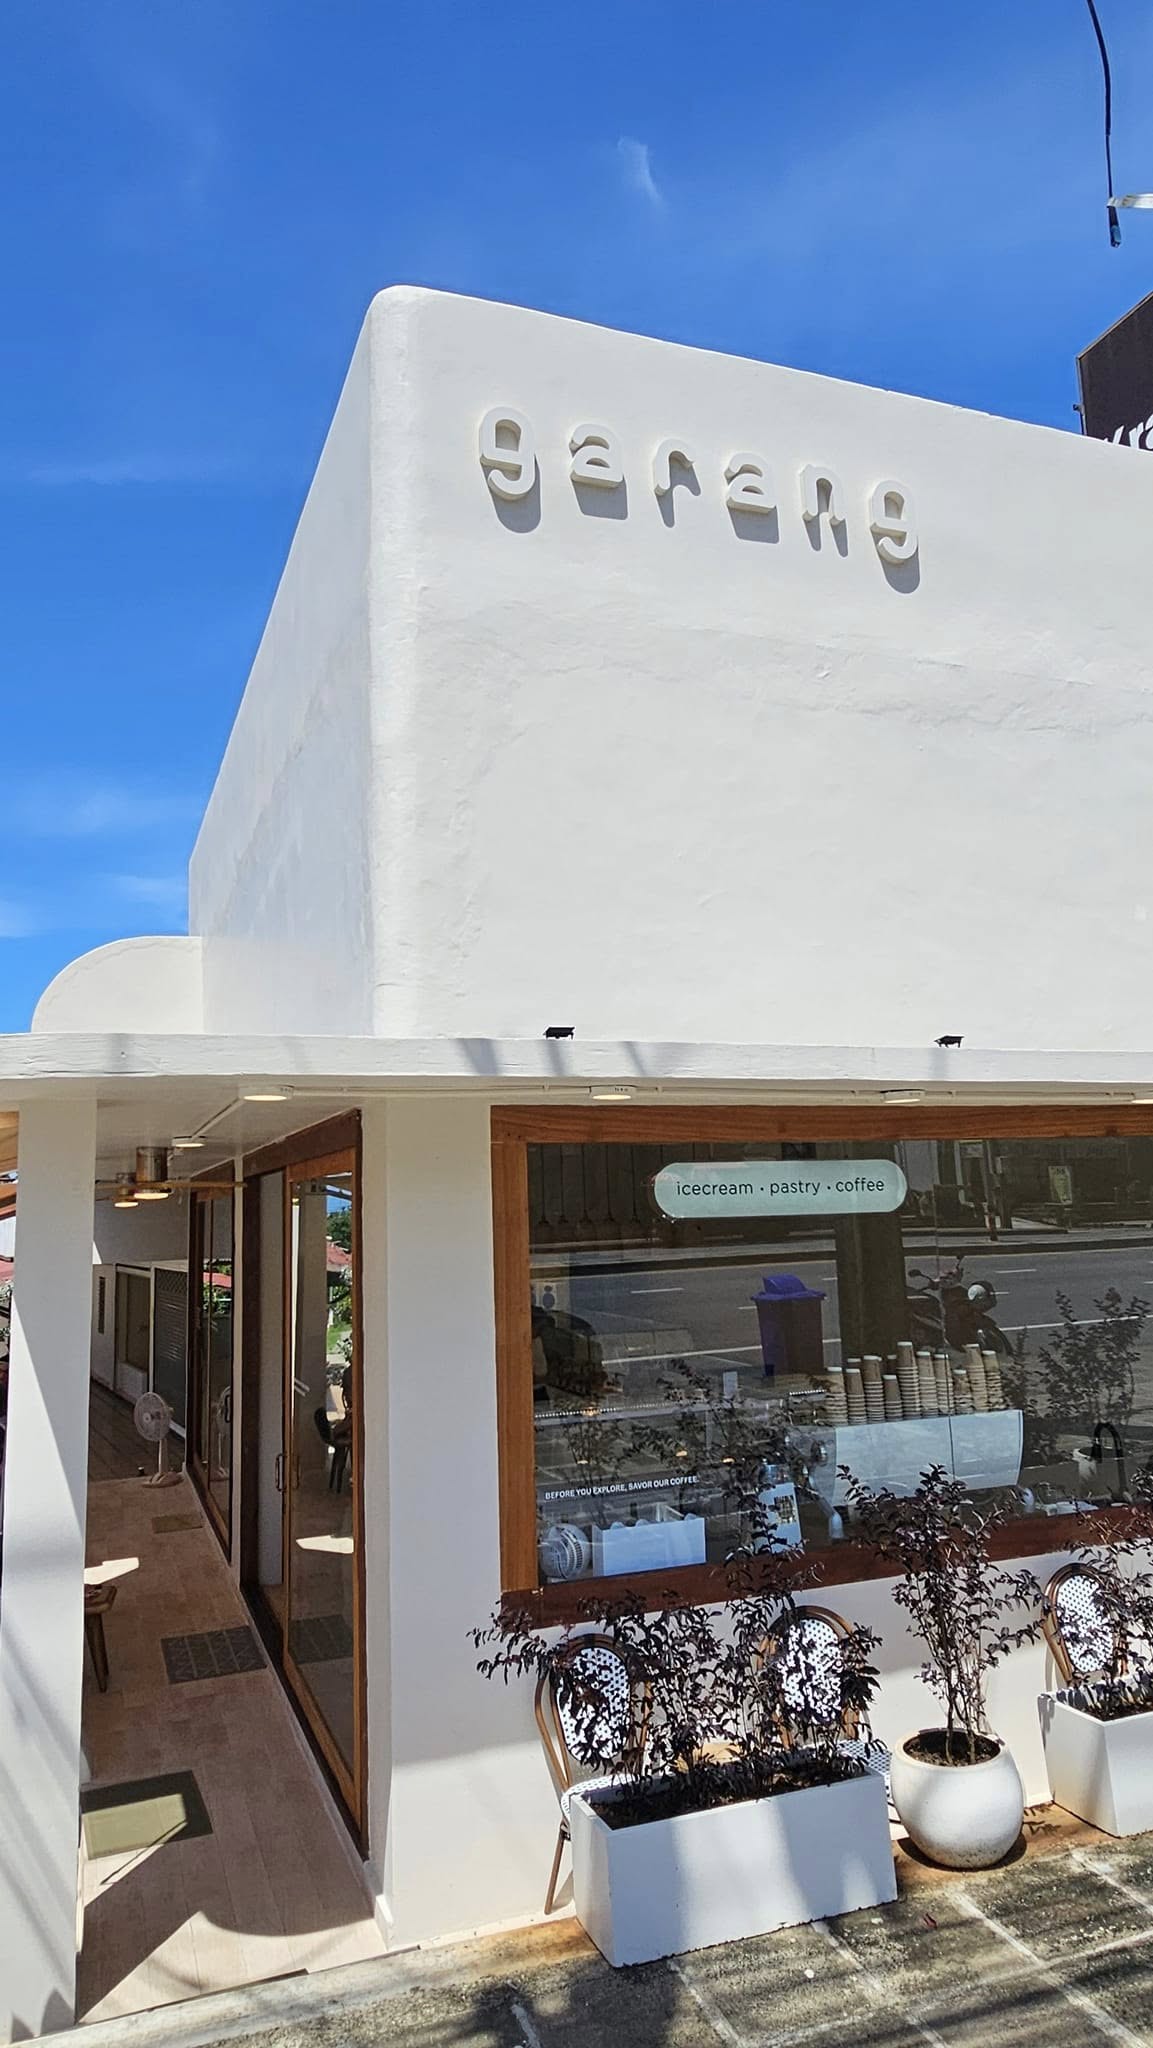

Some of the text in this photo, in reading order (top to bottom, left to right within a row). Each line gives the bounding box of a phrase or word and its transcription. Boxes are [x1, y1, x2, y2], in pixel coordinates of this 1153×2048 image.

[478, 406, 919, 562] garang
[677, 1177, 884, 1196] icecream pastry coffee
[545, 1475, 699, 1500] BEFORE YOU EXPLORE, SAVOR OUR COFFEE.
